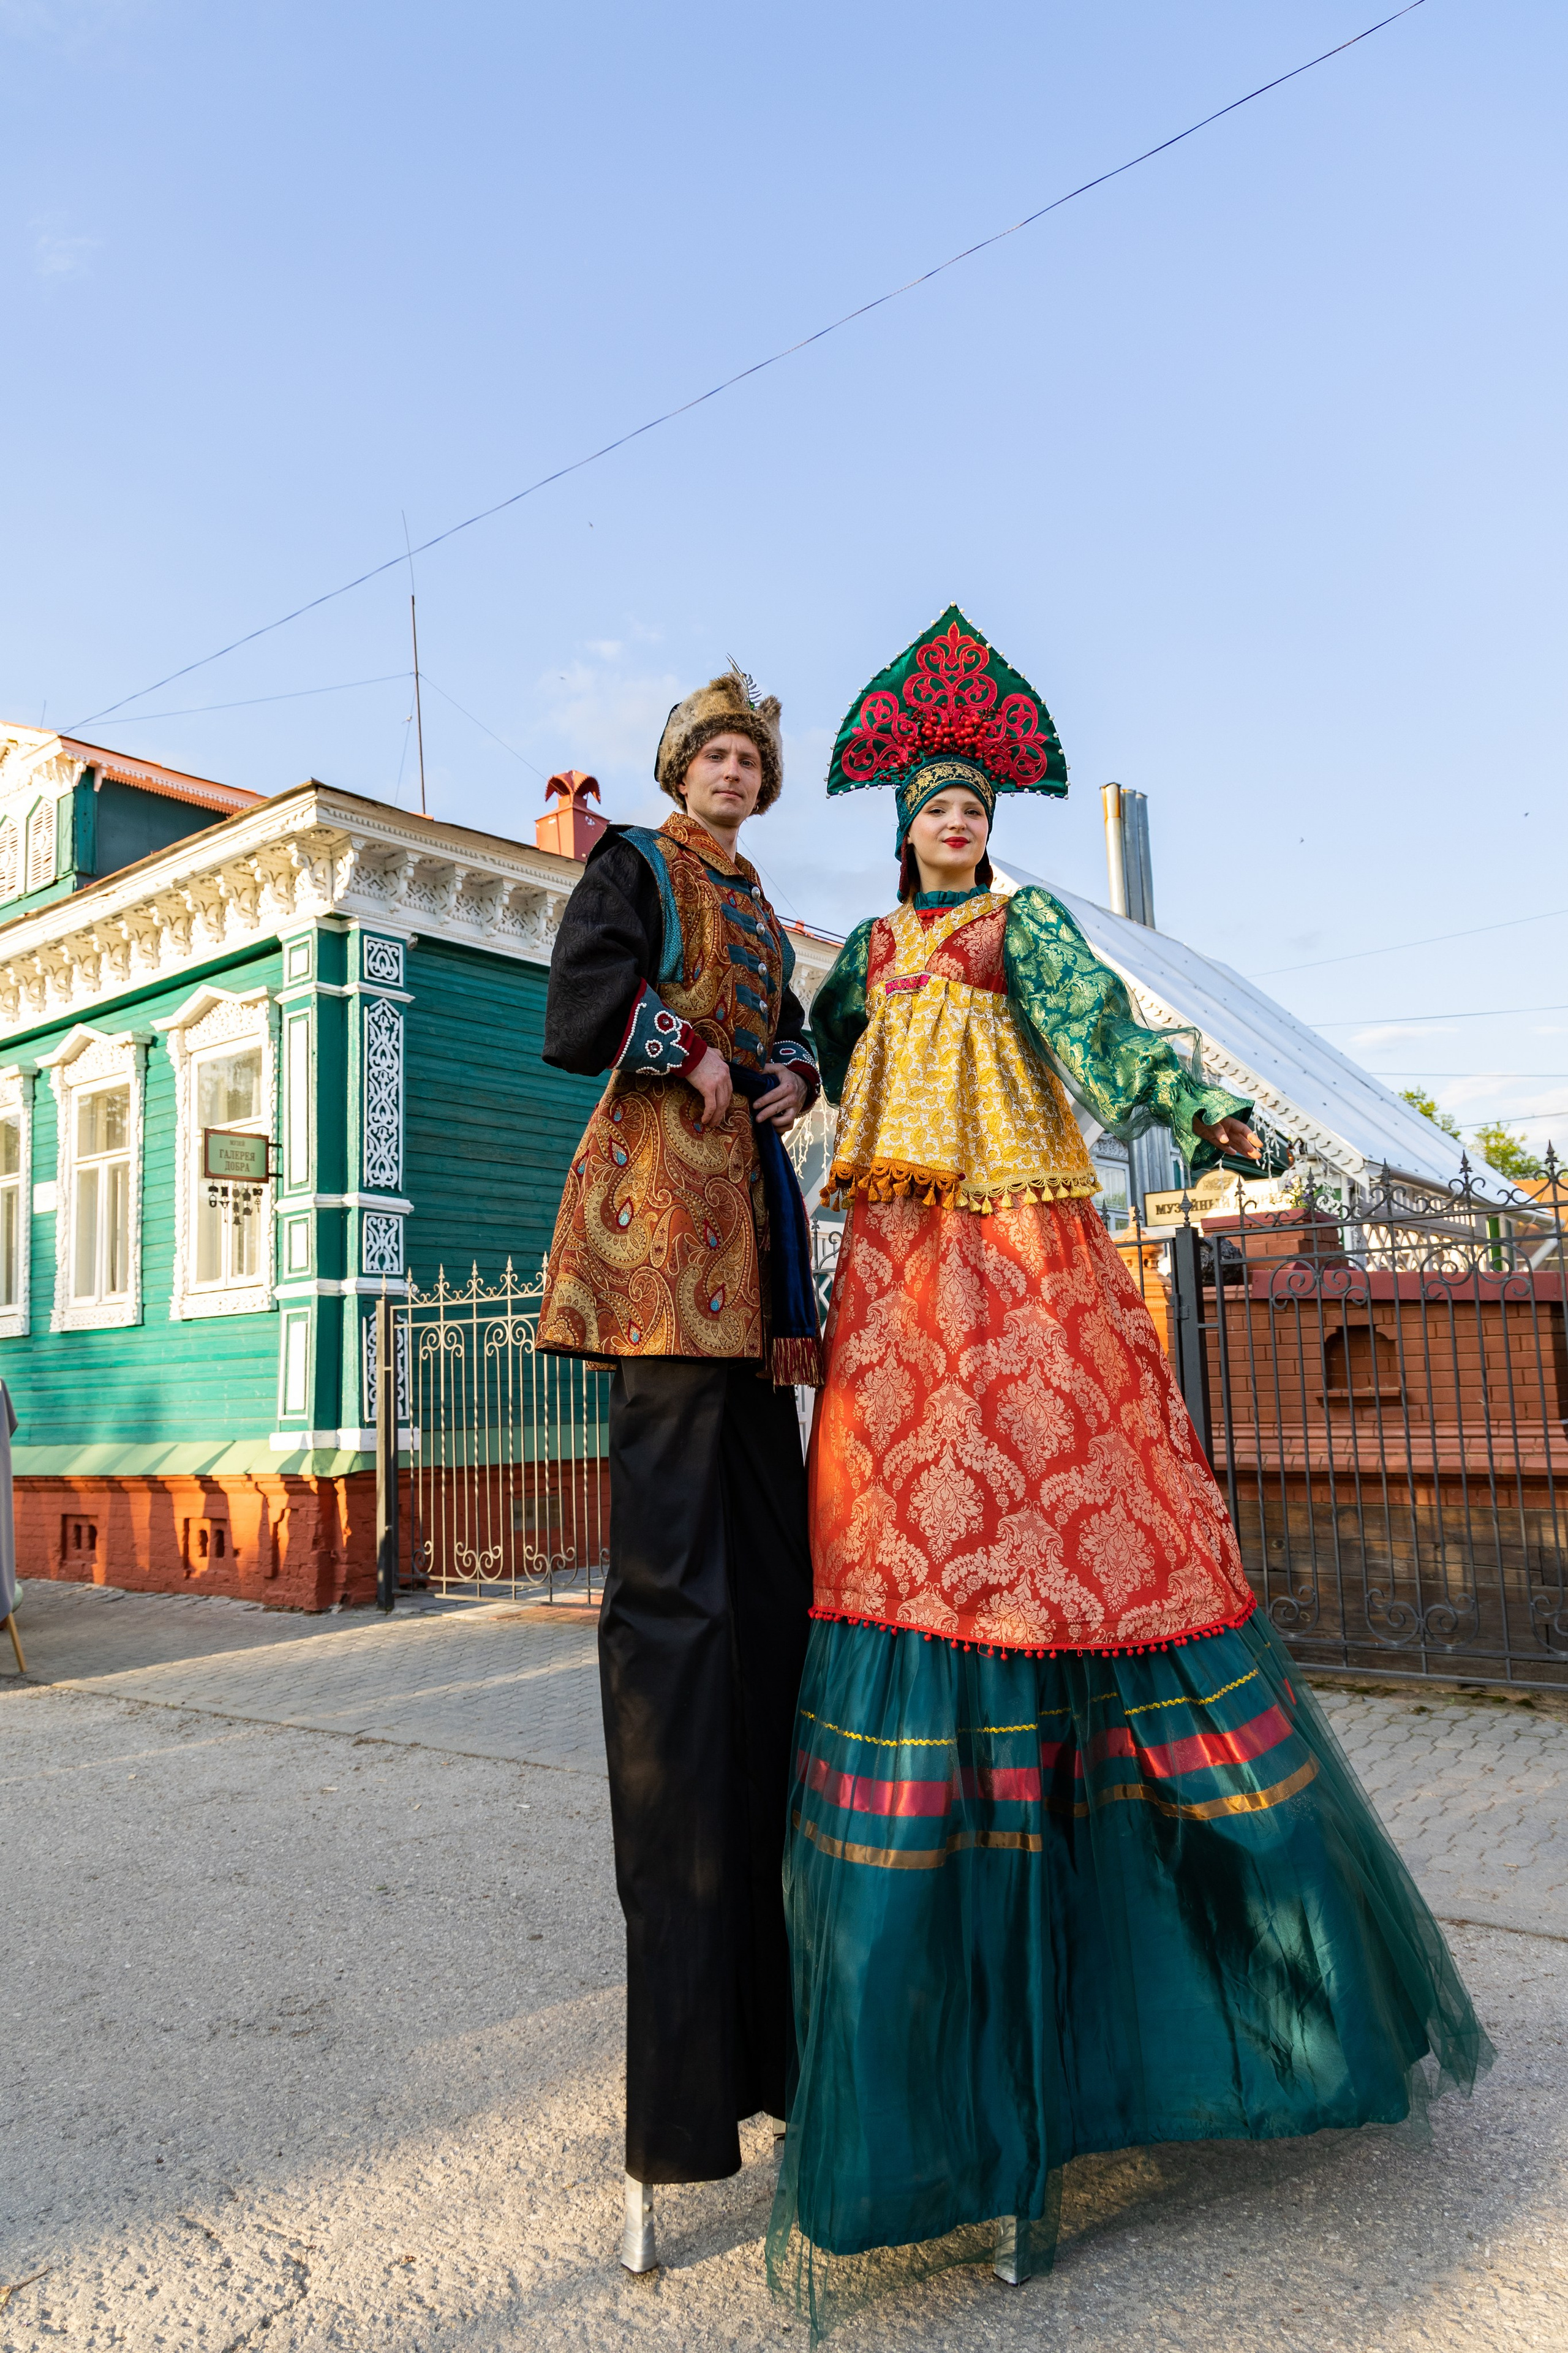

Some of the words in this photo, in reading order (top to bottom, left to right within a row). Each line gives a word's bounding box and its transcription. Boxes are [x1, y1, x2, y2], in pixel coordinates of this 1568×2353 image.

[219, 1149, 255, 1161] ГАЛЕРЕЯ
[224, 1161, 250, 1172] ДОБРА
[1156, 1195, 1230, 1215] МУЗЙНЫЙ
